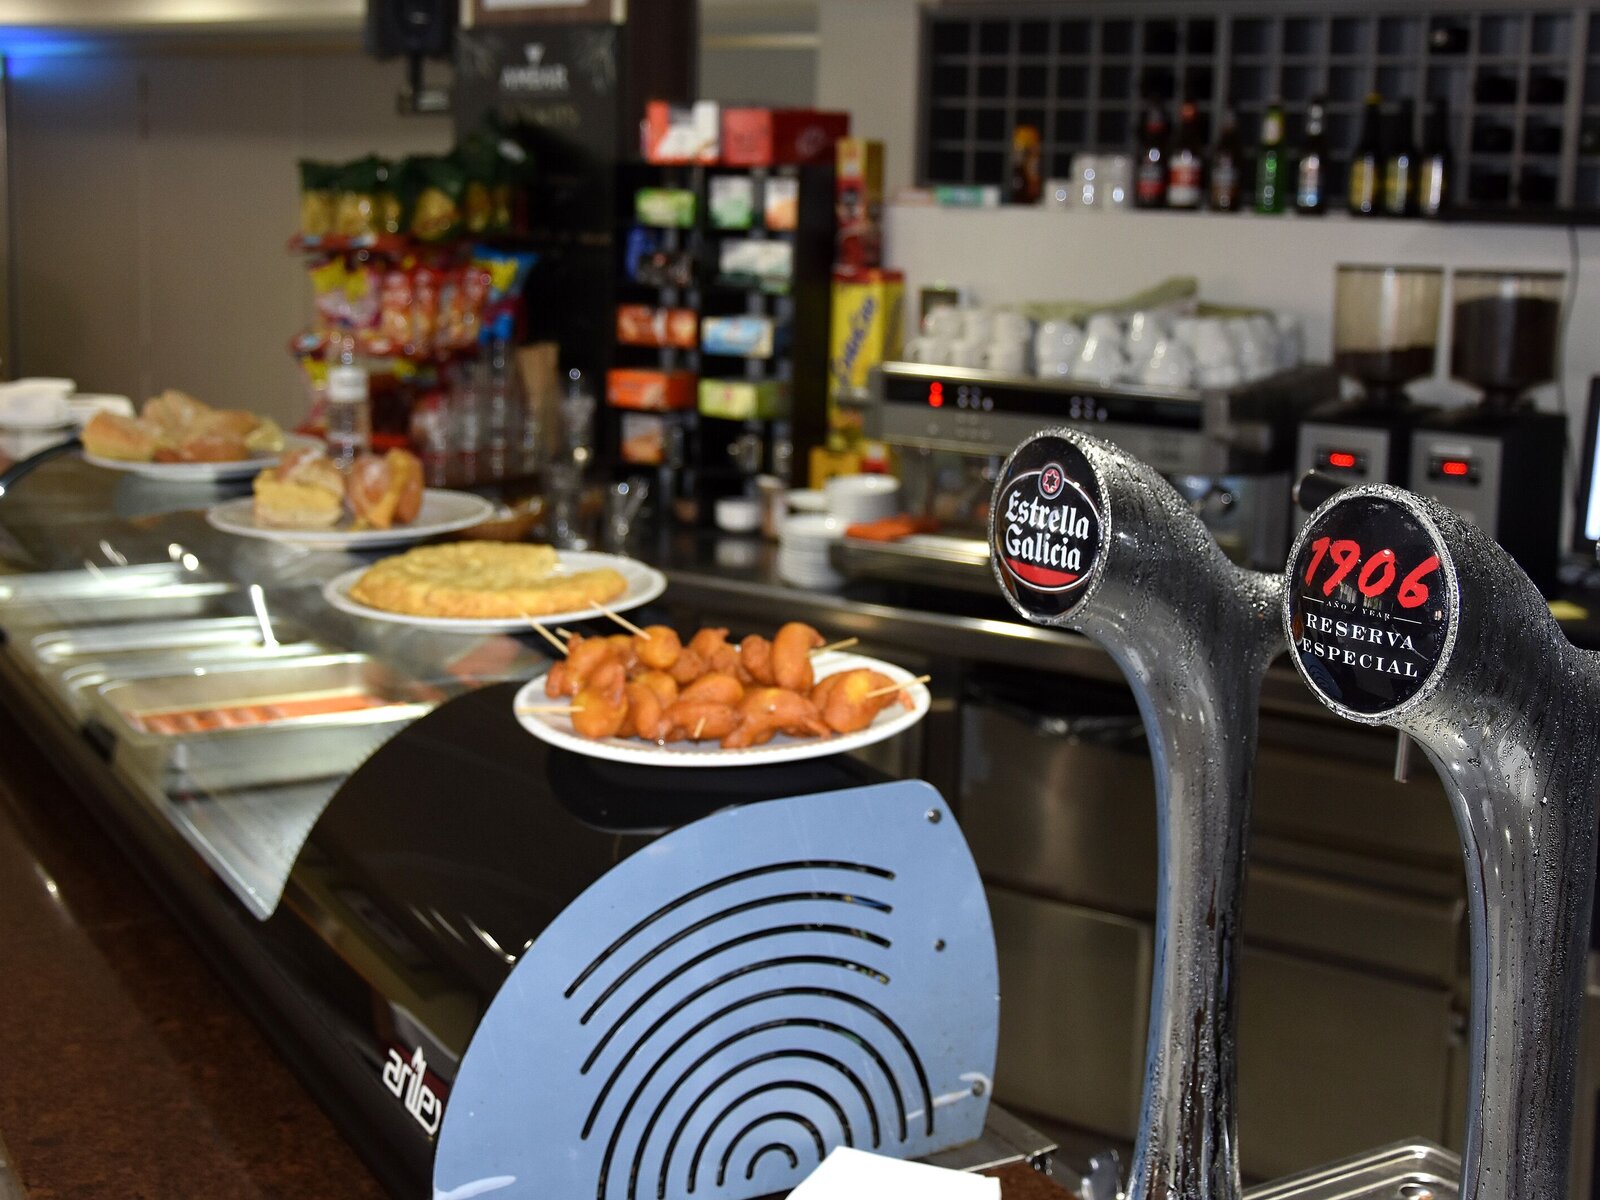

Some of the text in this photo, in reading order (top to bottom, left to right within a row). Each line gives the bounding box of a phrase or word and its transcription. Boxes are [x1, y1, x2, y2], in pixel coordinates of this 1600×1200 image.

[1005, 490, 1089, 540] Estrella
[1005, 523, 1080, 571] Galicia
[1304, 537, 1440, 608] 1906
[1306, 613, 1416, 651] RESERVA
[1326, 600, 1347, 610] AÑO
[1362, 608, 1391, 621] YEAR
[1302, 637, 1418, 678] ESPECIAL
